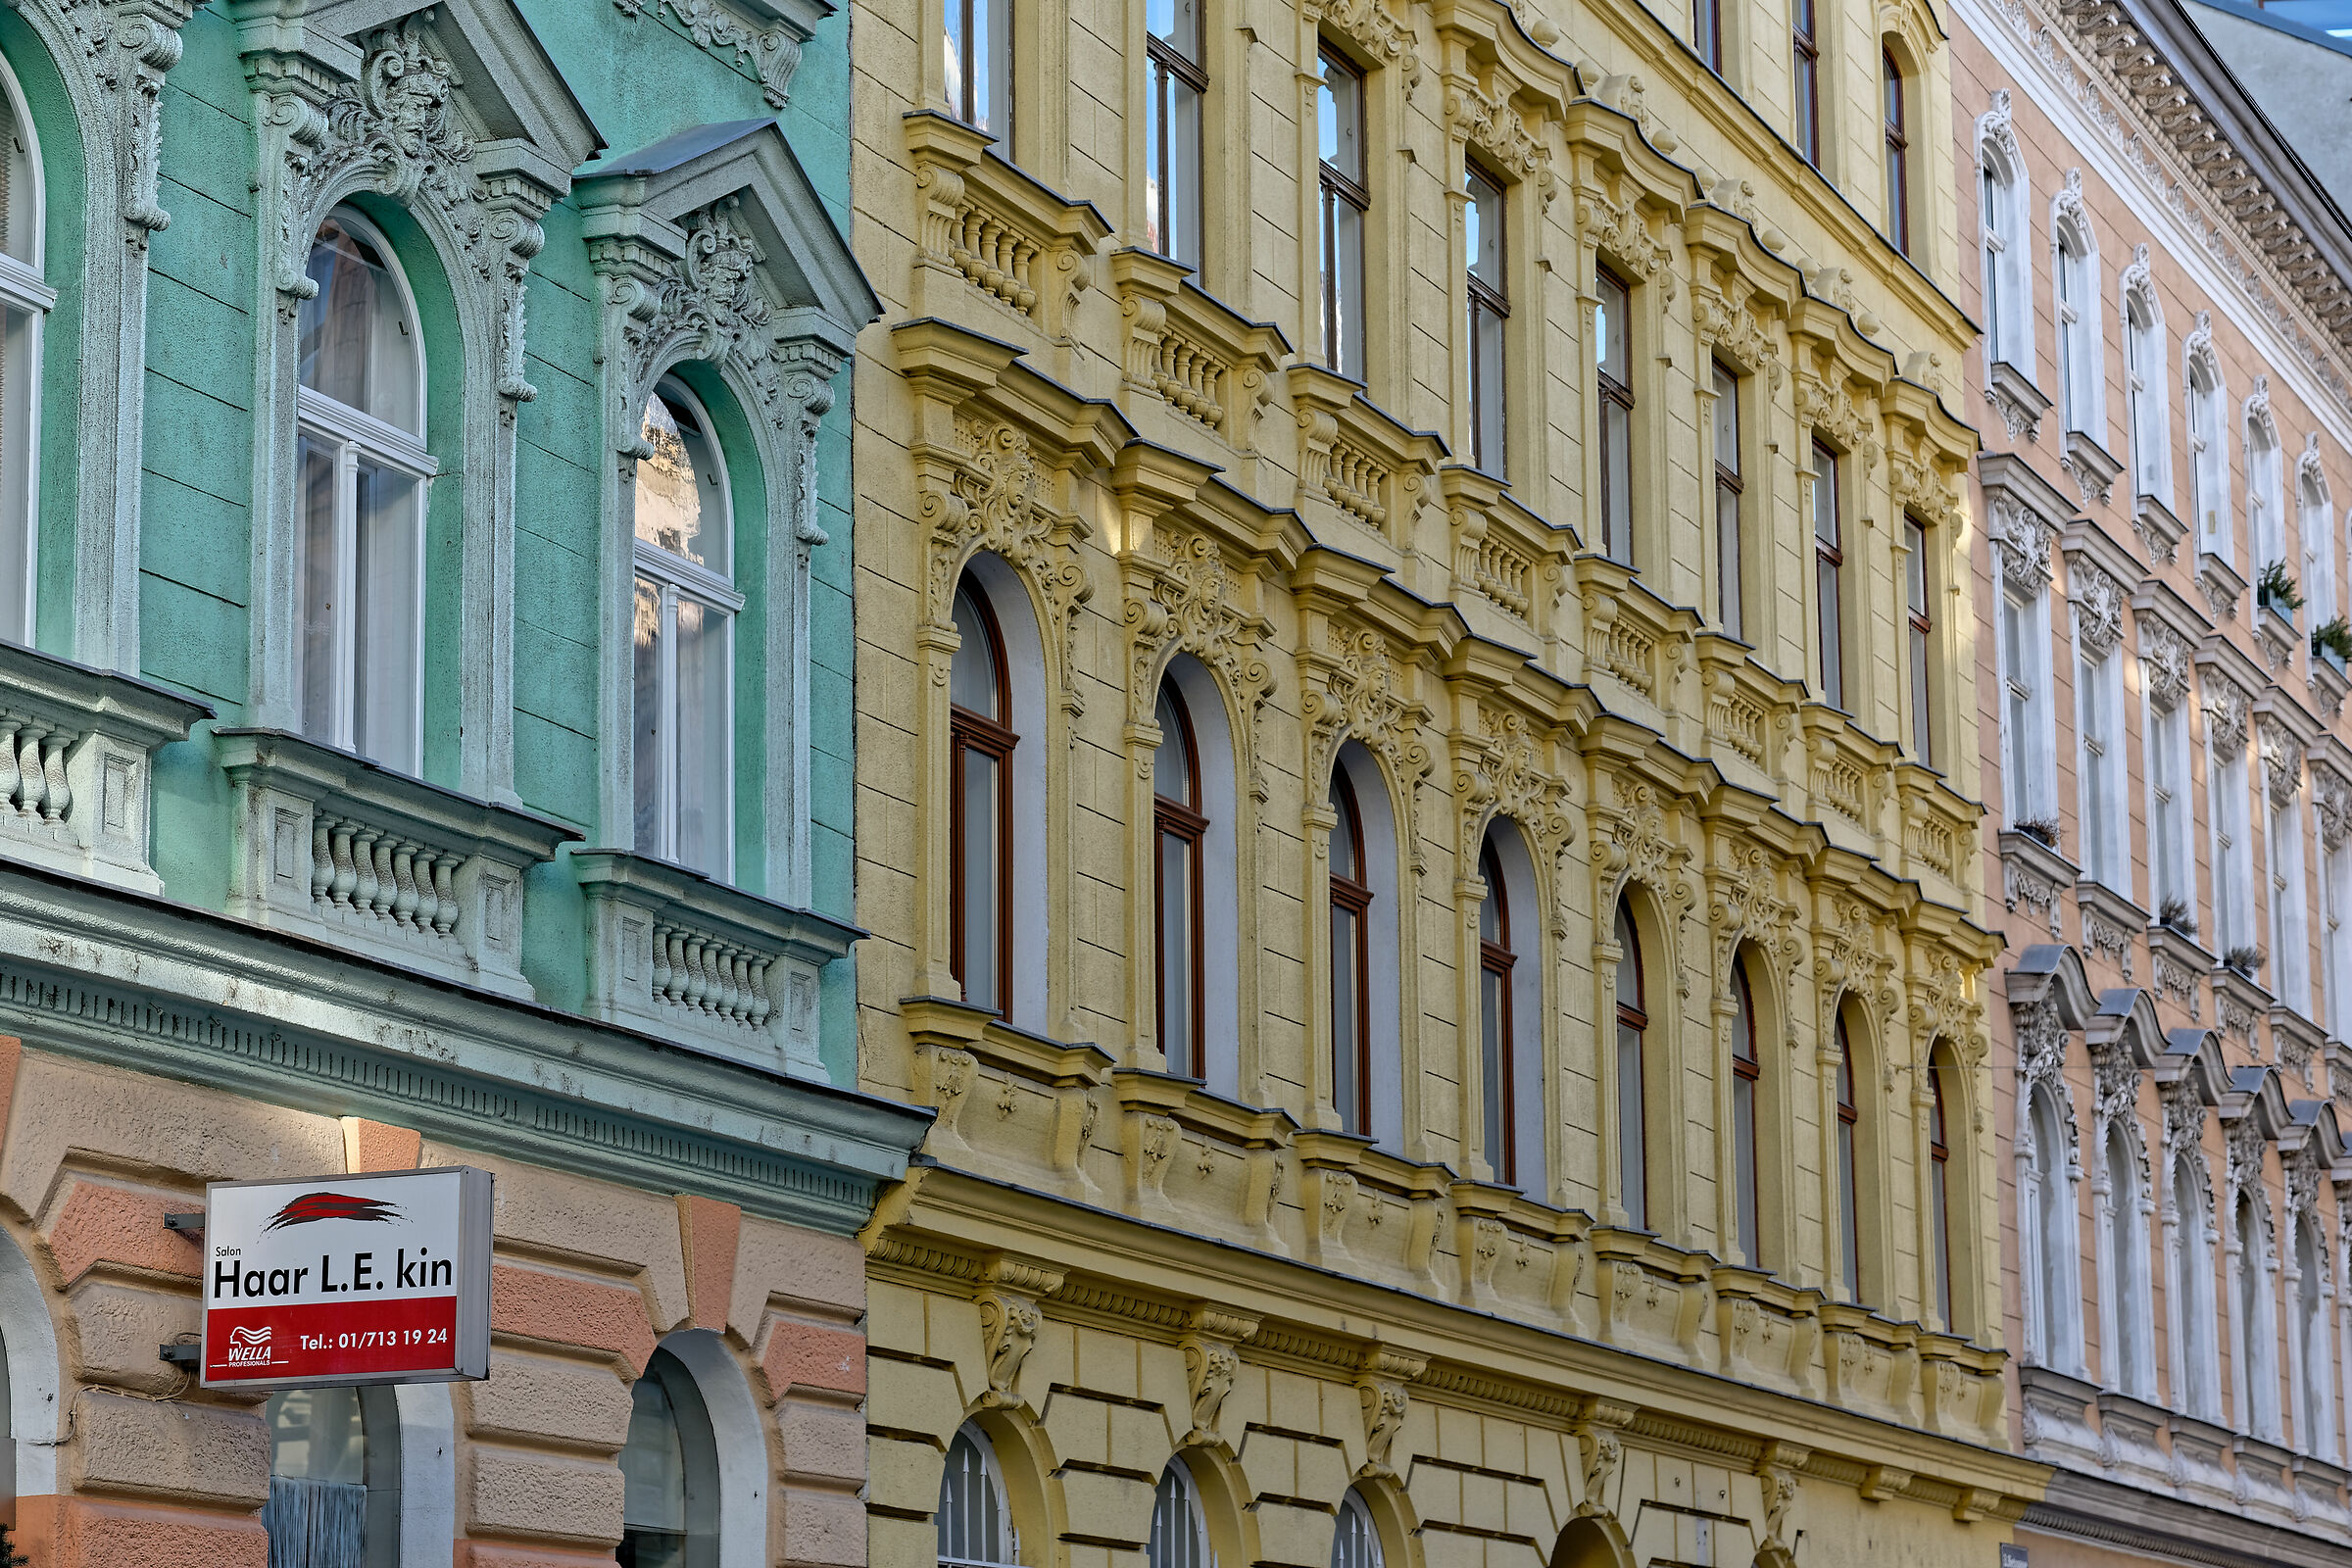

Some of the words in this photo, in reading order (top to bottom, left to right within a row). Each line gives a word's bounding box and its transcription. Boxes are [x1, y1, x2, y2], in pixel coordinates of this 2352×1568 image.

[215, 1247, 242, 1257] Salon
[214, 1259, 309, 1298] Haar
[320, 1251, 384, 1293] L.E.
[396, 1247, 452, 1289] kin
[300, 1335, 333, 1350] Tel.:
[338, 1331, 397, 1348] 01/713
[404, 1330, 422, 1345] 19
[427, 1328, 448, 1344] 24
[228, 1346, 271, 1361] WELLA
